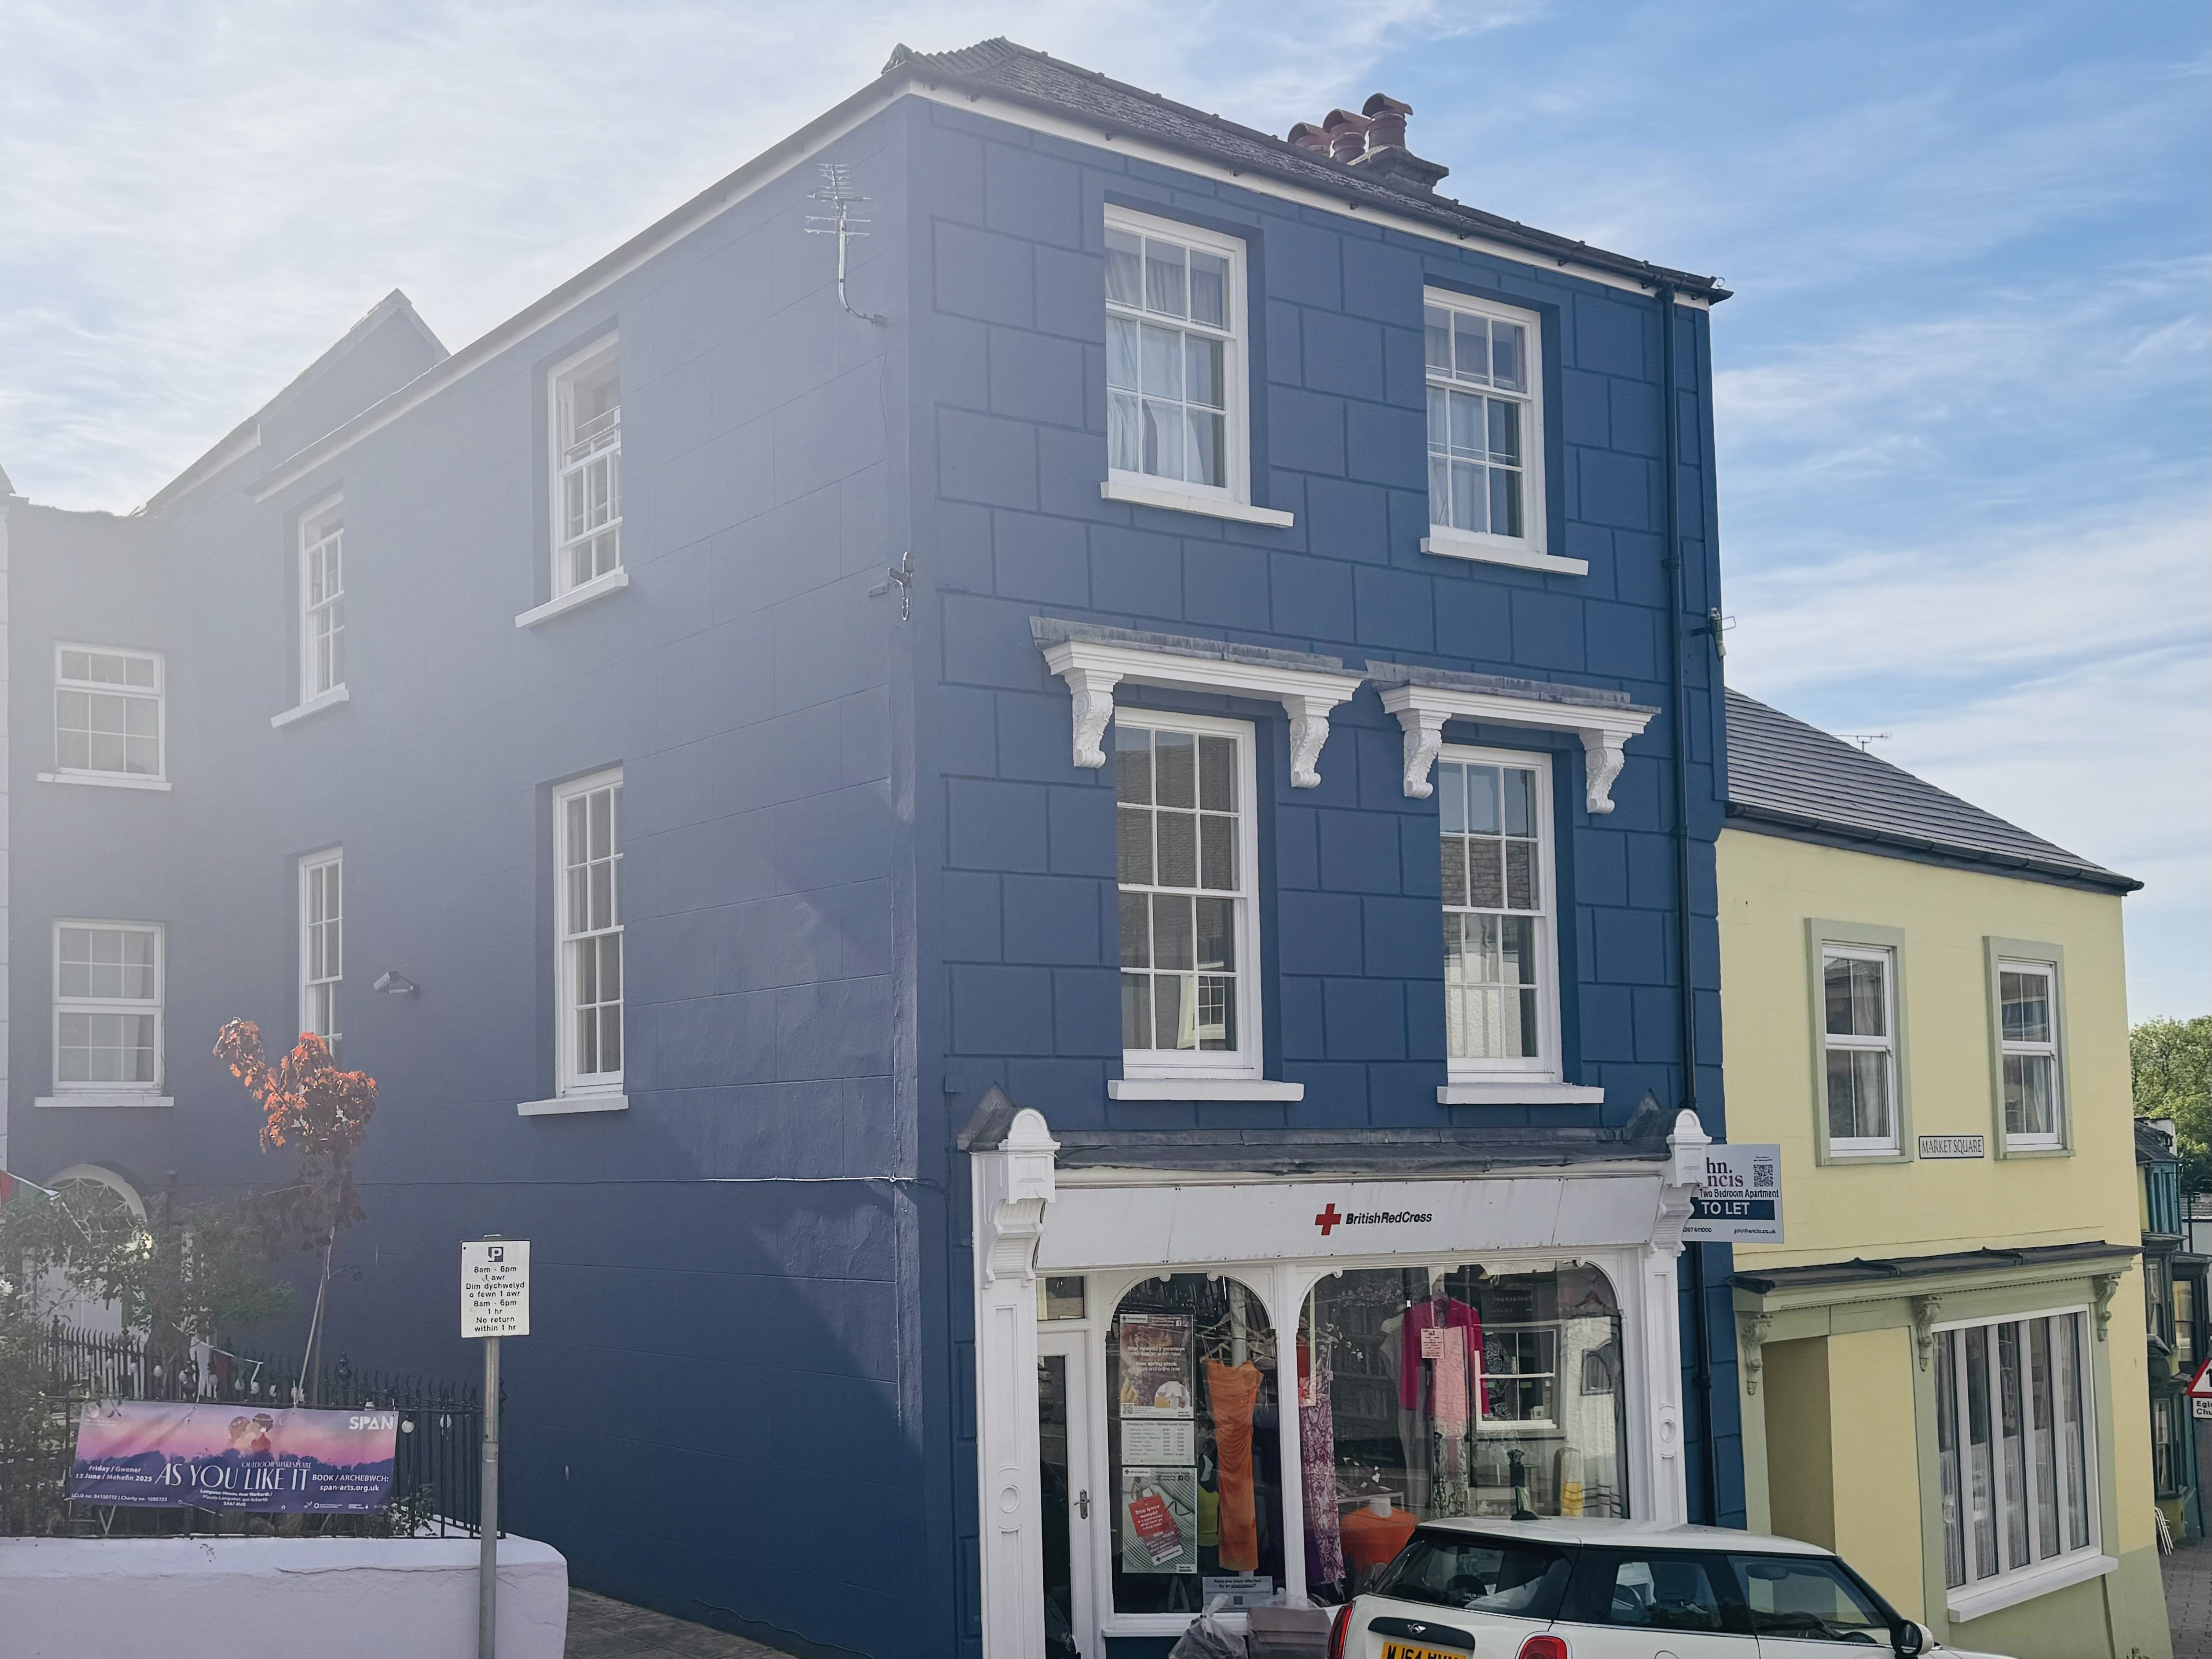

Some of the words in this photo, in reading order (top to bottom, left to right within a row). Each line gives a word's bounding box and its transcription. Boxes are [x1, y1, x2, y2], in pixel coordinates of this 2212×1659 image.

[1922, 1140, 1952, 1153] MARKET
[1953, 1139, 1982, 1154] SQUARE
[1706, 1157, 1733, 1174] hn.
[1708, 1174, 1744, 1187] ncis
[1700, 1189, 1712, 1198] Two
[1714, 1189, 1744, 1198] Bedroom
[1745, 1189, 1779, 1199] Apartment
[1701, 1202, 1722, 1215] TO
[1725, 1202, 1750, 1215] LET
[1346, 1212, 1432, 1224] BritishRedCross
[484, 1282, 525, 1290] dychwelyd
[349, 1416, 394, 1430] SPAN
[155, 1463, 183, 1486] AS
[190, 1464, 239, 1489] YOU
[244, 1468, 286, 1490] LIKE
[292, 1468, 311, 1490] IT
[320, 1484, 380, 1492] span-arts.org.uk
